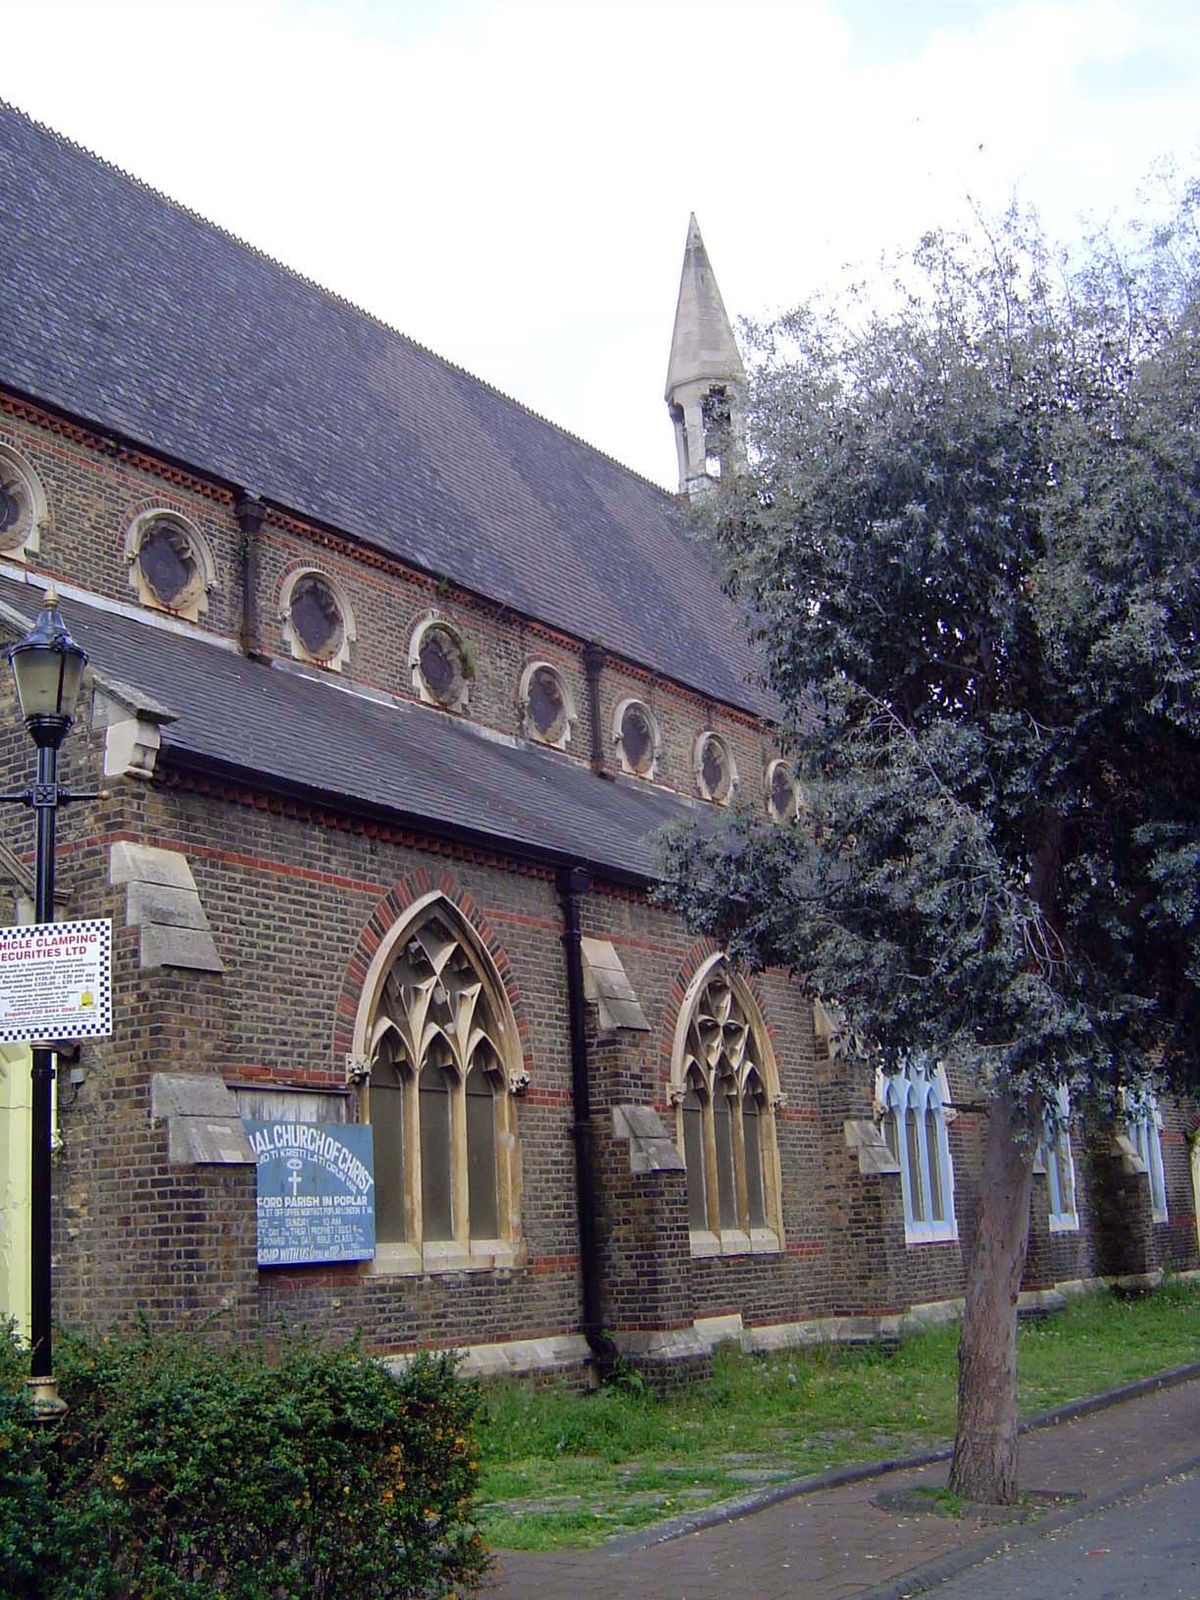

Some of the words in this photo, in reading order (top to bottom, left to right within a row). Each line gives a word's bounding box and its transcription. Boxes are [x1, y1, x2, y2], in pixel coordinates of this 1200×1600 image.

[36, 934, 97, 947] CLAMPING
[1, 948, 61, 961] ECURITIES
[66, 946, 87, 956] LTD
[273, 1124, 325, 1154] CHURCH
[324, 1137, 341, 1162] OF
[339, 1147, 374, 1194] CHRIST
[281, 1148, 307, 1158] KRISTI
[257, 1196, 283, 1208] FORD
[284, 1196, 320, 1208] PARISH
[322, 1195, 333, 1206] IN
[334, 1195, 368, 1206] POPLAR
[280, 1247, 299, 1261] WITH
